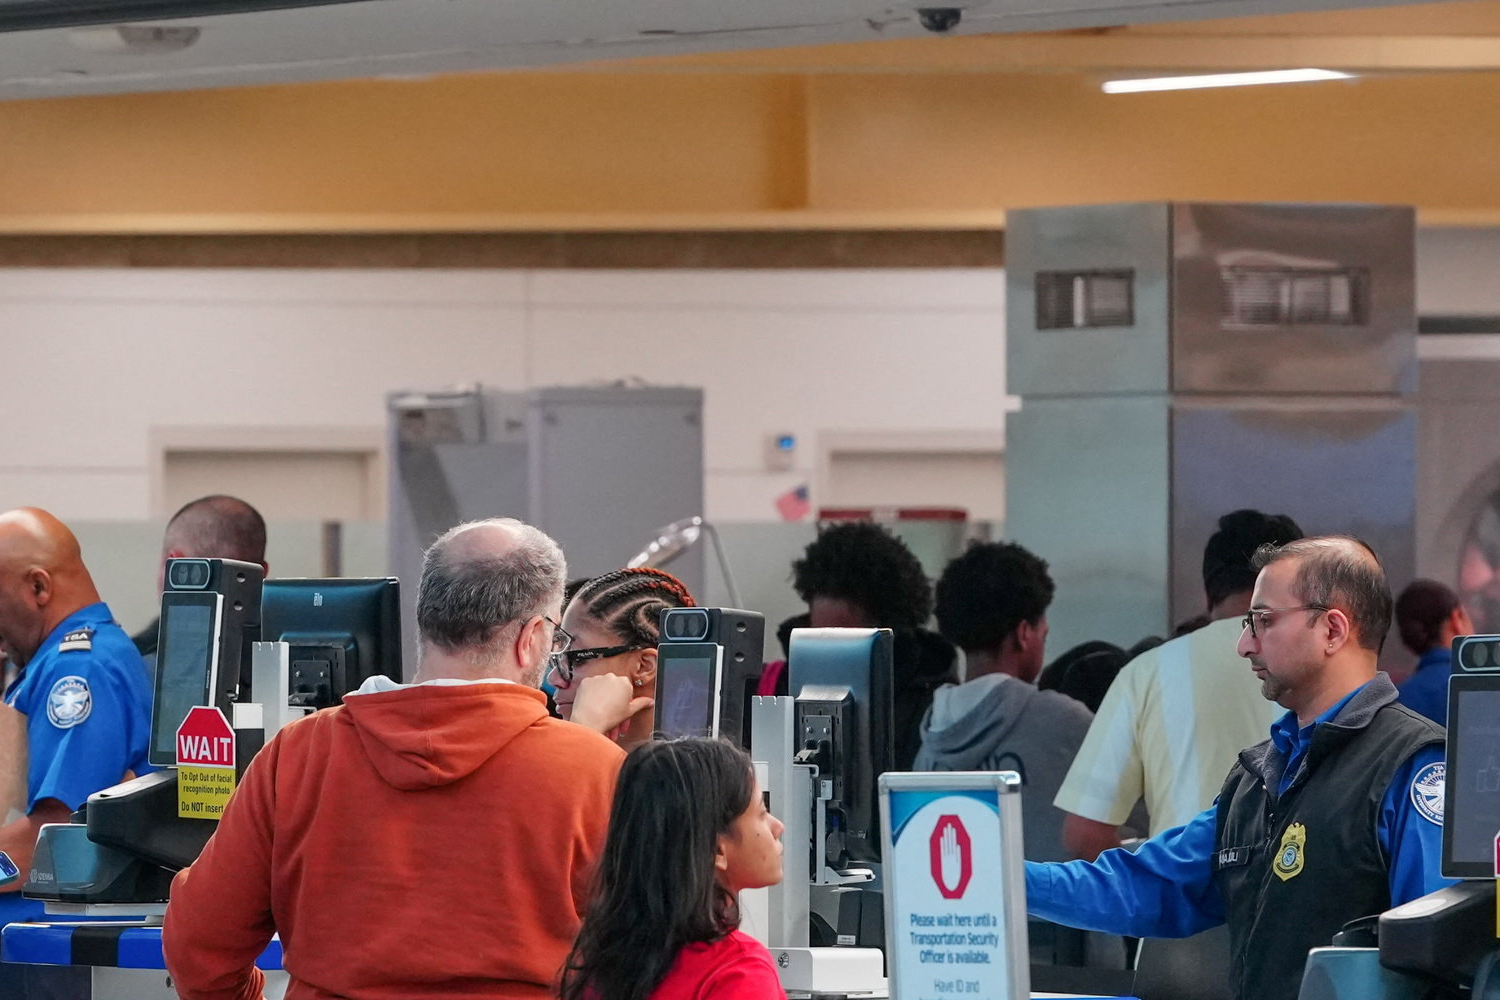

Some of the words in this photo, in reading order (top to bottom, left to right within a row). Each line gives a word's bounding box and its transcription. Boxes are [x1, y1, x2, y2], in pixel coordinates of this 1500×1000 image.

[180, 734, 232, 762] WAIT
[181, 772, 188, 780] To
[189, 772, 198, 782] Opt
[200, 773, 209, 782] Out
[210, 773, 216, 782] of
[217, 774, 232, 783] facial
[183, 785, 214, 795] recognition
[215, 786, 231, 796] photo
[181, 801, 190, 811] Do
[191, 802, 204, 812] NOT
[205, 803, 224, 813] insert
[910, 913, 935, 927] Please
[937, 913, 953, 927] wait
[955, 913, 972, 927] here
[974, 912, 990, 927] until
[992, 915, 998, 927] a
[910, 931, 966, 947] Transportation
[967, 931, 998, 948] Security
[920, 949, 945, 964] Officer
[947, 949, 954, 963] is
[955, 949, 991, 964] available.
[933, 978, 954, 993] Have
[956, 979, 964, 993] ID
[965, 979, 980, 993] and
